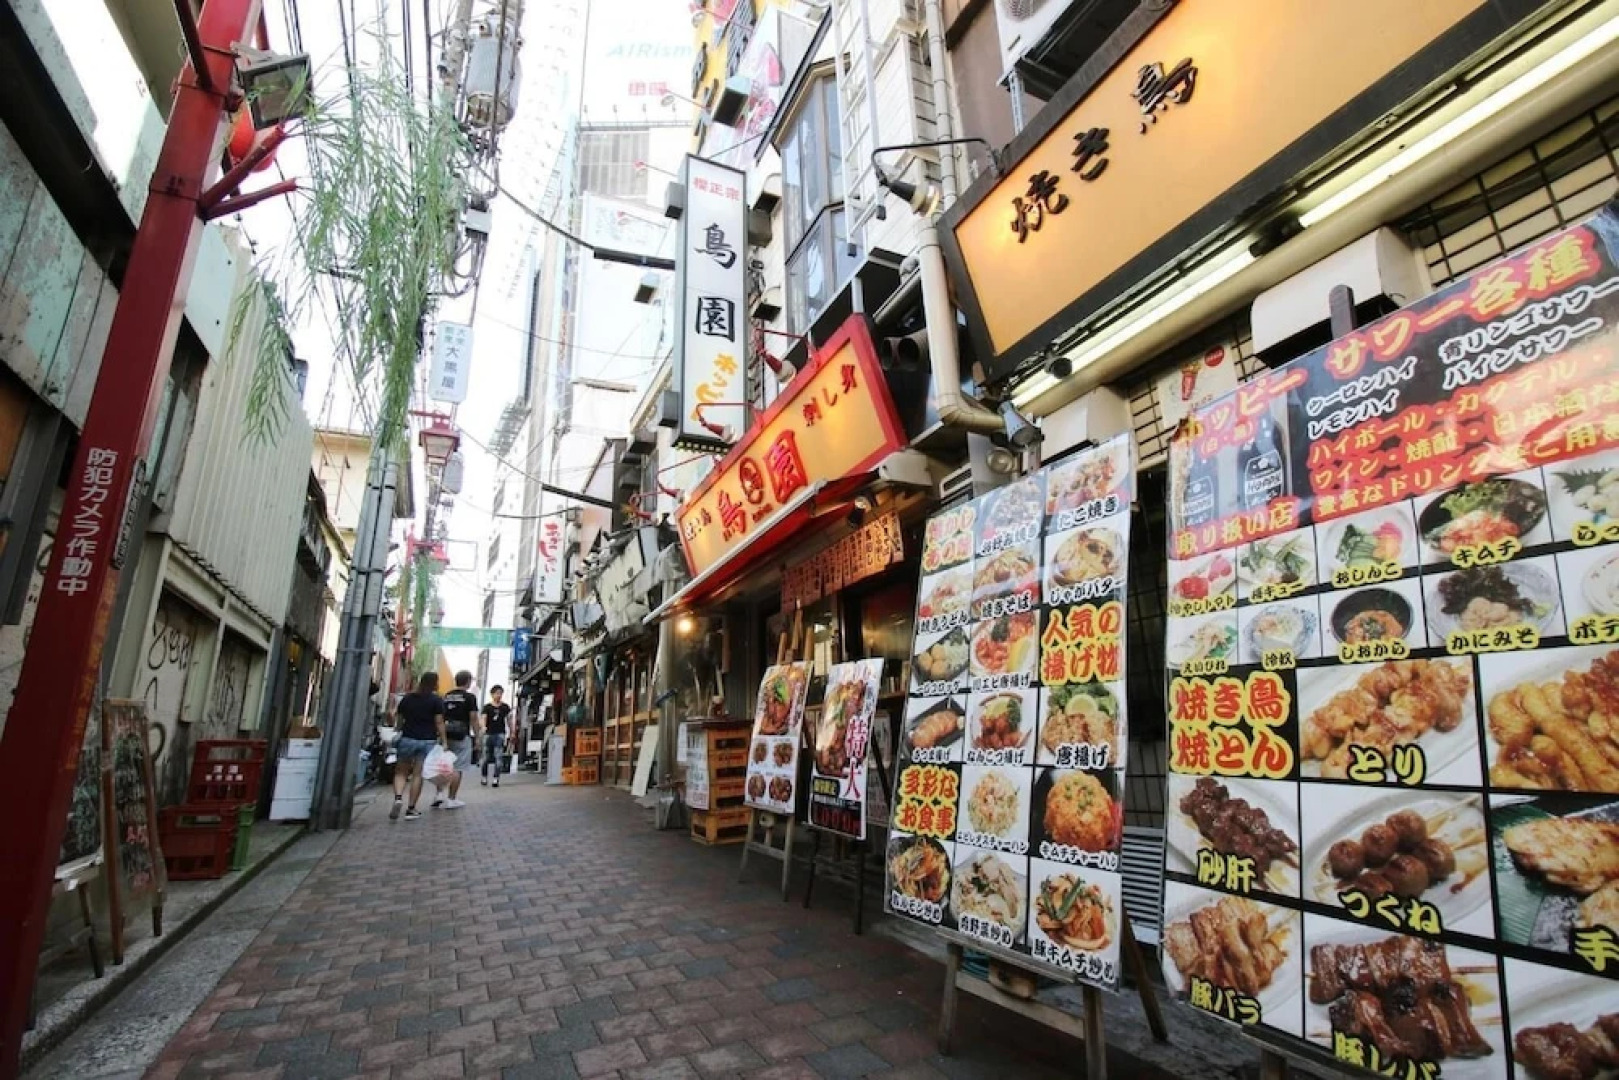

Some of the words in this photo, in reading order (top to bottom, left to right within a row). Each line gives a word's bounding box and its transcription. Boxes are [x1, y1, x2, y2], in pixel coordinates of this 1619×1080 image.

[1010, 57, 1198, 243] 焼き鳥
[695, 222, 737, 343] 鳥園
[1329, 235, 1591, 374] サワー各種
[1443, 318, 1603, 389] パインサワー
[803, 364, 858, 428] 刺し身
[1308, 389, 1400, 439] レモンハイ
[57, 447, 118, 596] 防犯カメラ作動中
[1059, 496, 1116, 528] たこ焼き
[1177, 502, 1295, 554] 取り扱い店
[1456, 542, 1519, 563] キムチ
[1050, 578, 1124, 603] じゃがバター
[1334, 563, 1401, 584] おしんこ
[982, 592, 1030, 617] 焼きそば
[1169, 596, 1235, 614] 冷やしトマト
[1044, 606, 1120, 645] 人気の
[1450, 628, 1536, 650] かにみそ
[1043, 643, 1120, 681] 揚げ物
[1341, 642, 1406, 661] しおから
[1174, 674, 1284, 720] 焼き鳥
[967, 750, 1023, 764] なんこつ揚げ
[1057, 746, 1107, 767] 唐揚げ
[1174, 731, 1287, 773] 焼とん
[1349, 744, 1426, 785] とり
[904, 769, 955, 798] 多彩な
[900, 803, 953, 832] お食事
[1041, 844, 1117, 868] キムチチャーハン
[1198, 851, 1254, 892] 砂肝
[1341, 893, 1441, 934] つくね
[1574, 930, 1619, 971] 手
[1191, 979, 1261, 1024] 豚バラ
